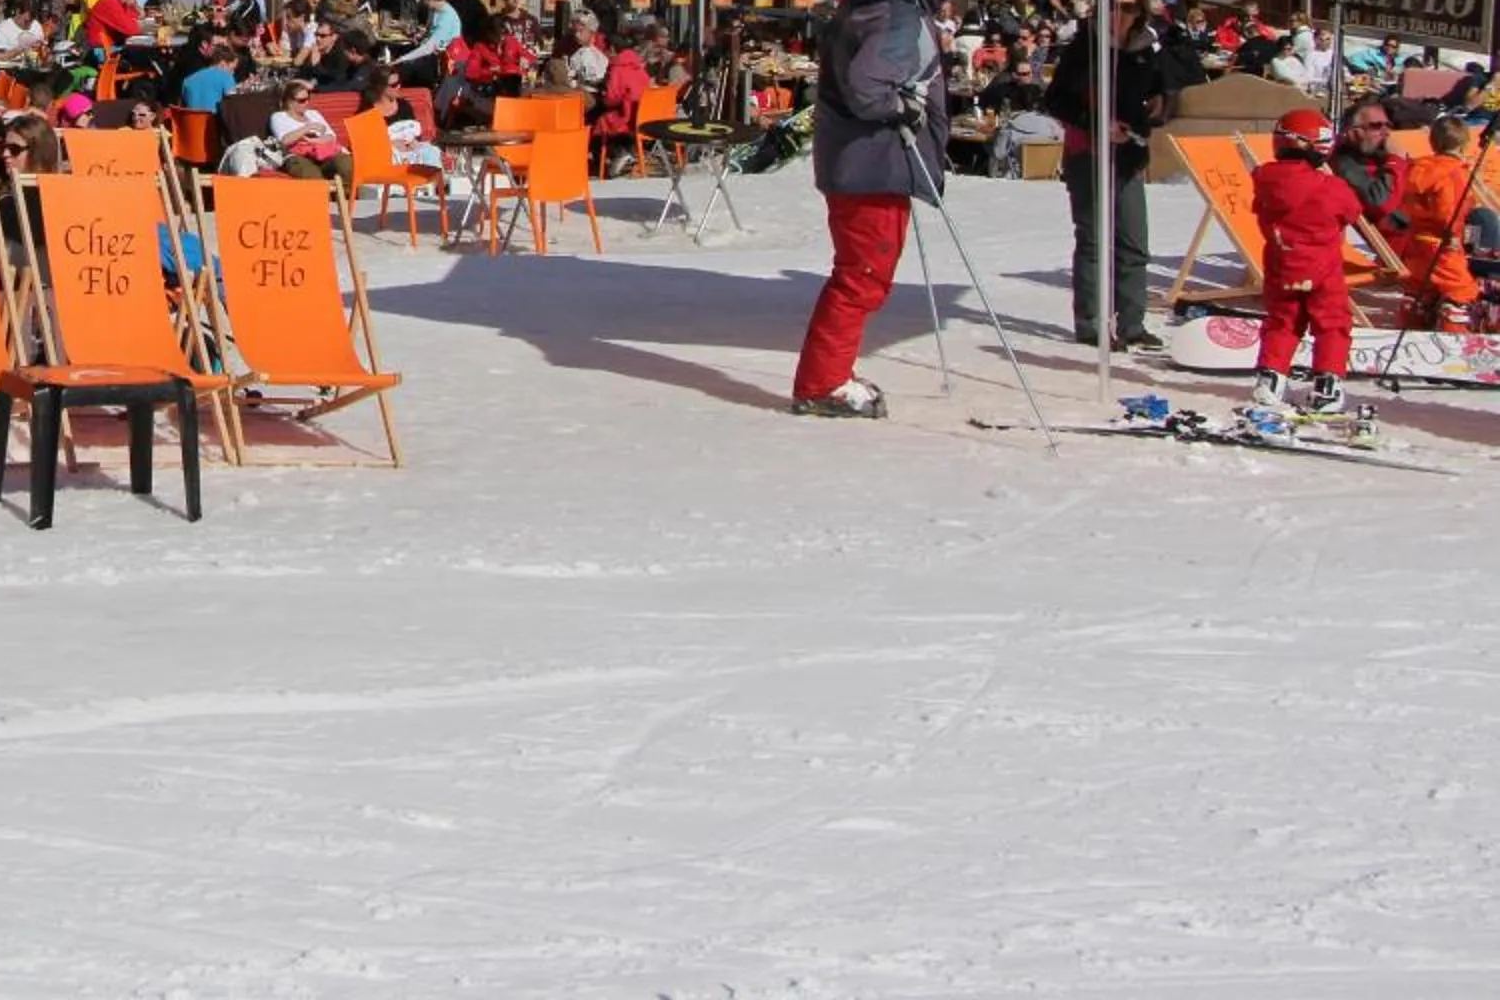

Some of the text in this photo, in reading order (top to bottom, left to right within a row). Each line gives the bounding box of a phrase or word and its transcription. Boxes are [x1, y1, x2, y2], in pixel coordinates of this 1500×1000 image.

[1376, 13, 1482, 42] RESTAURANT
[64, 217, 136, 257] Chez
[238, 214, 311, 251] Chez
[78, 258, 130, 296] Flo
[252, 252, 305, 288] Flo
